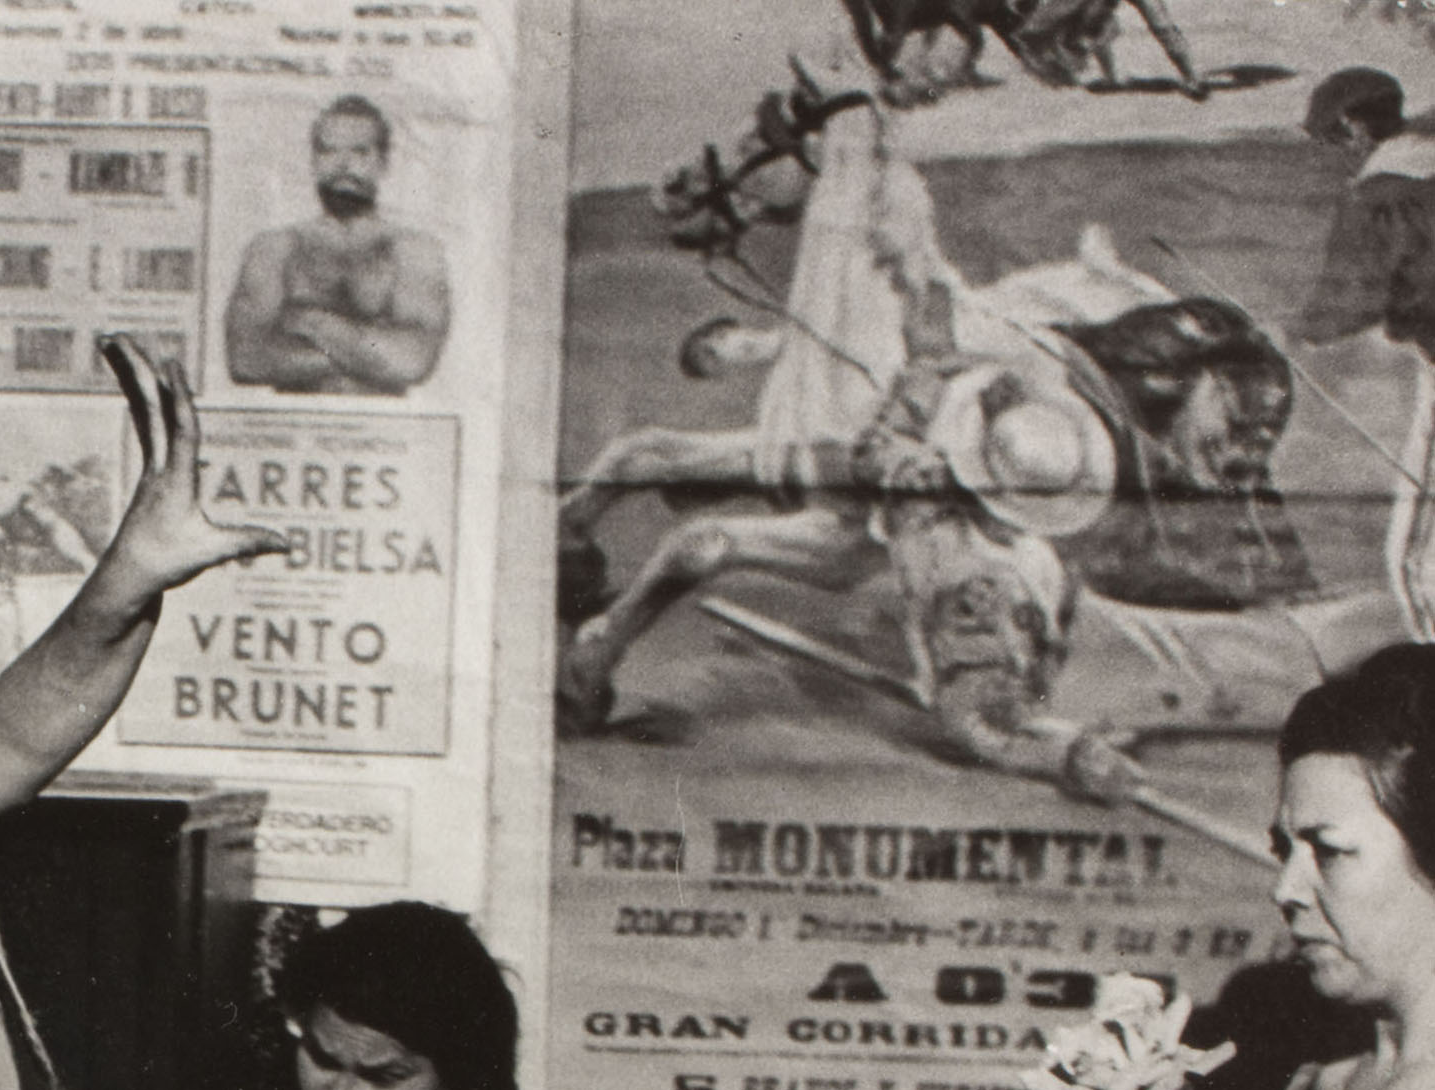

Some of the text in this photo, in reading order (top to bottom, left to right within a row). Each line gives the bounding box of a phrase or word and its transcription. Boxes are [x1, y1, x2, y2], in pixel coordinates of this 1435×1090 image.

[190, 614, 386, 664] VENTO
[174, 676, 395, 729] BRUNET
[263, 811, 394, 835] ERDADERO
[255, 836, 369, 856] OGHOURT
[572, 814, 1177, 889] Plaza MONUMENTAL
[584, 1012, 1048, 1051] GRAN CORRIDA
